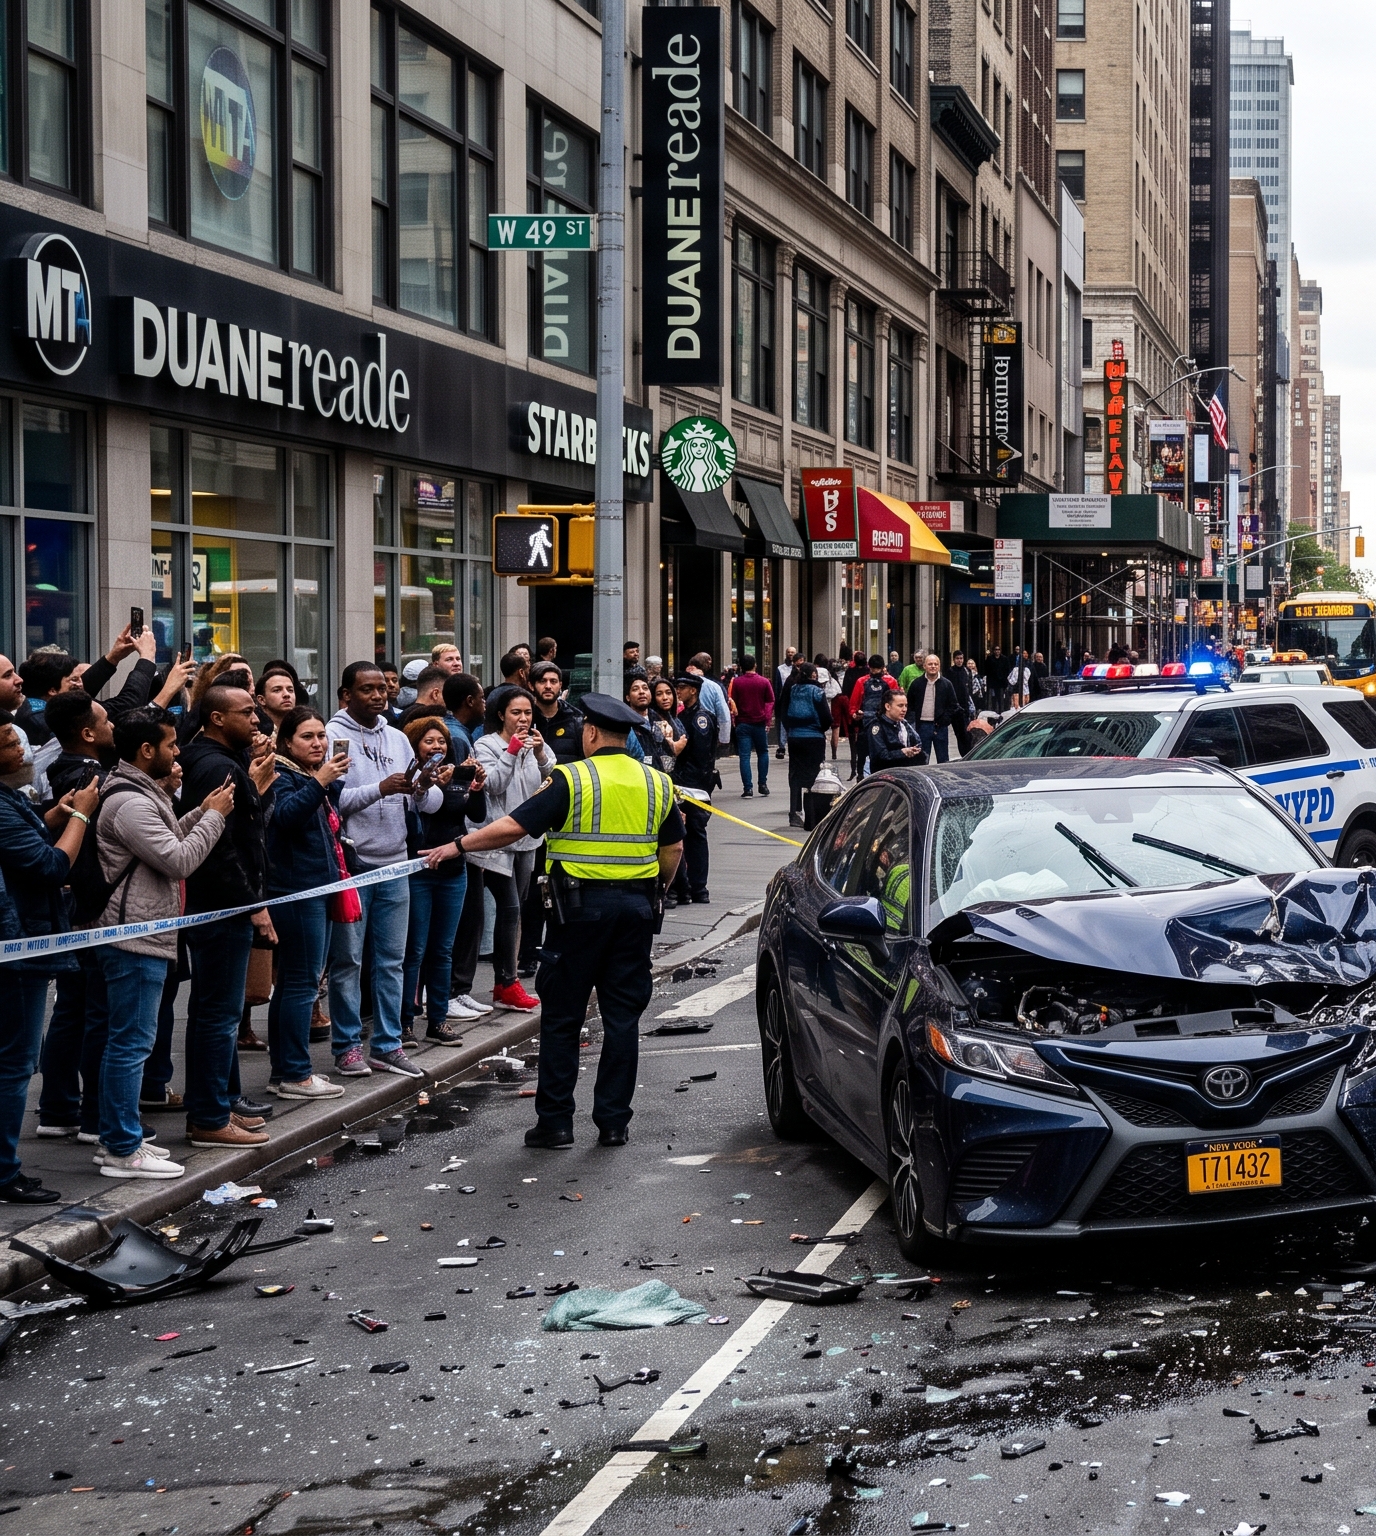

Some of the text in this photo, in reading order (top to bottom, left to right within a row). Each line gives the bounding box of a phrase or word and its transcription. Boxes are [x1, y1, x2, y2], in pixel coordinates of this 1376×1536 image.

[497, 220, 585, 245] W 49 ST
[27, 258, 92, 345] MTA
[527, 401, 650, 478] STARBKS
[1275, 786, 1335, 824] NYPD
[1199, 1152, 1270, 1183] T71432
